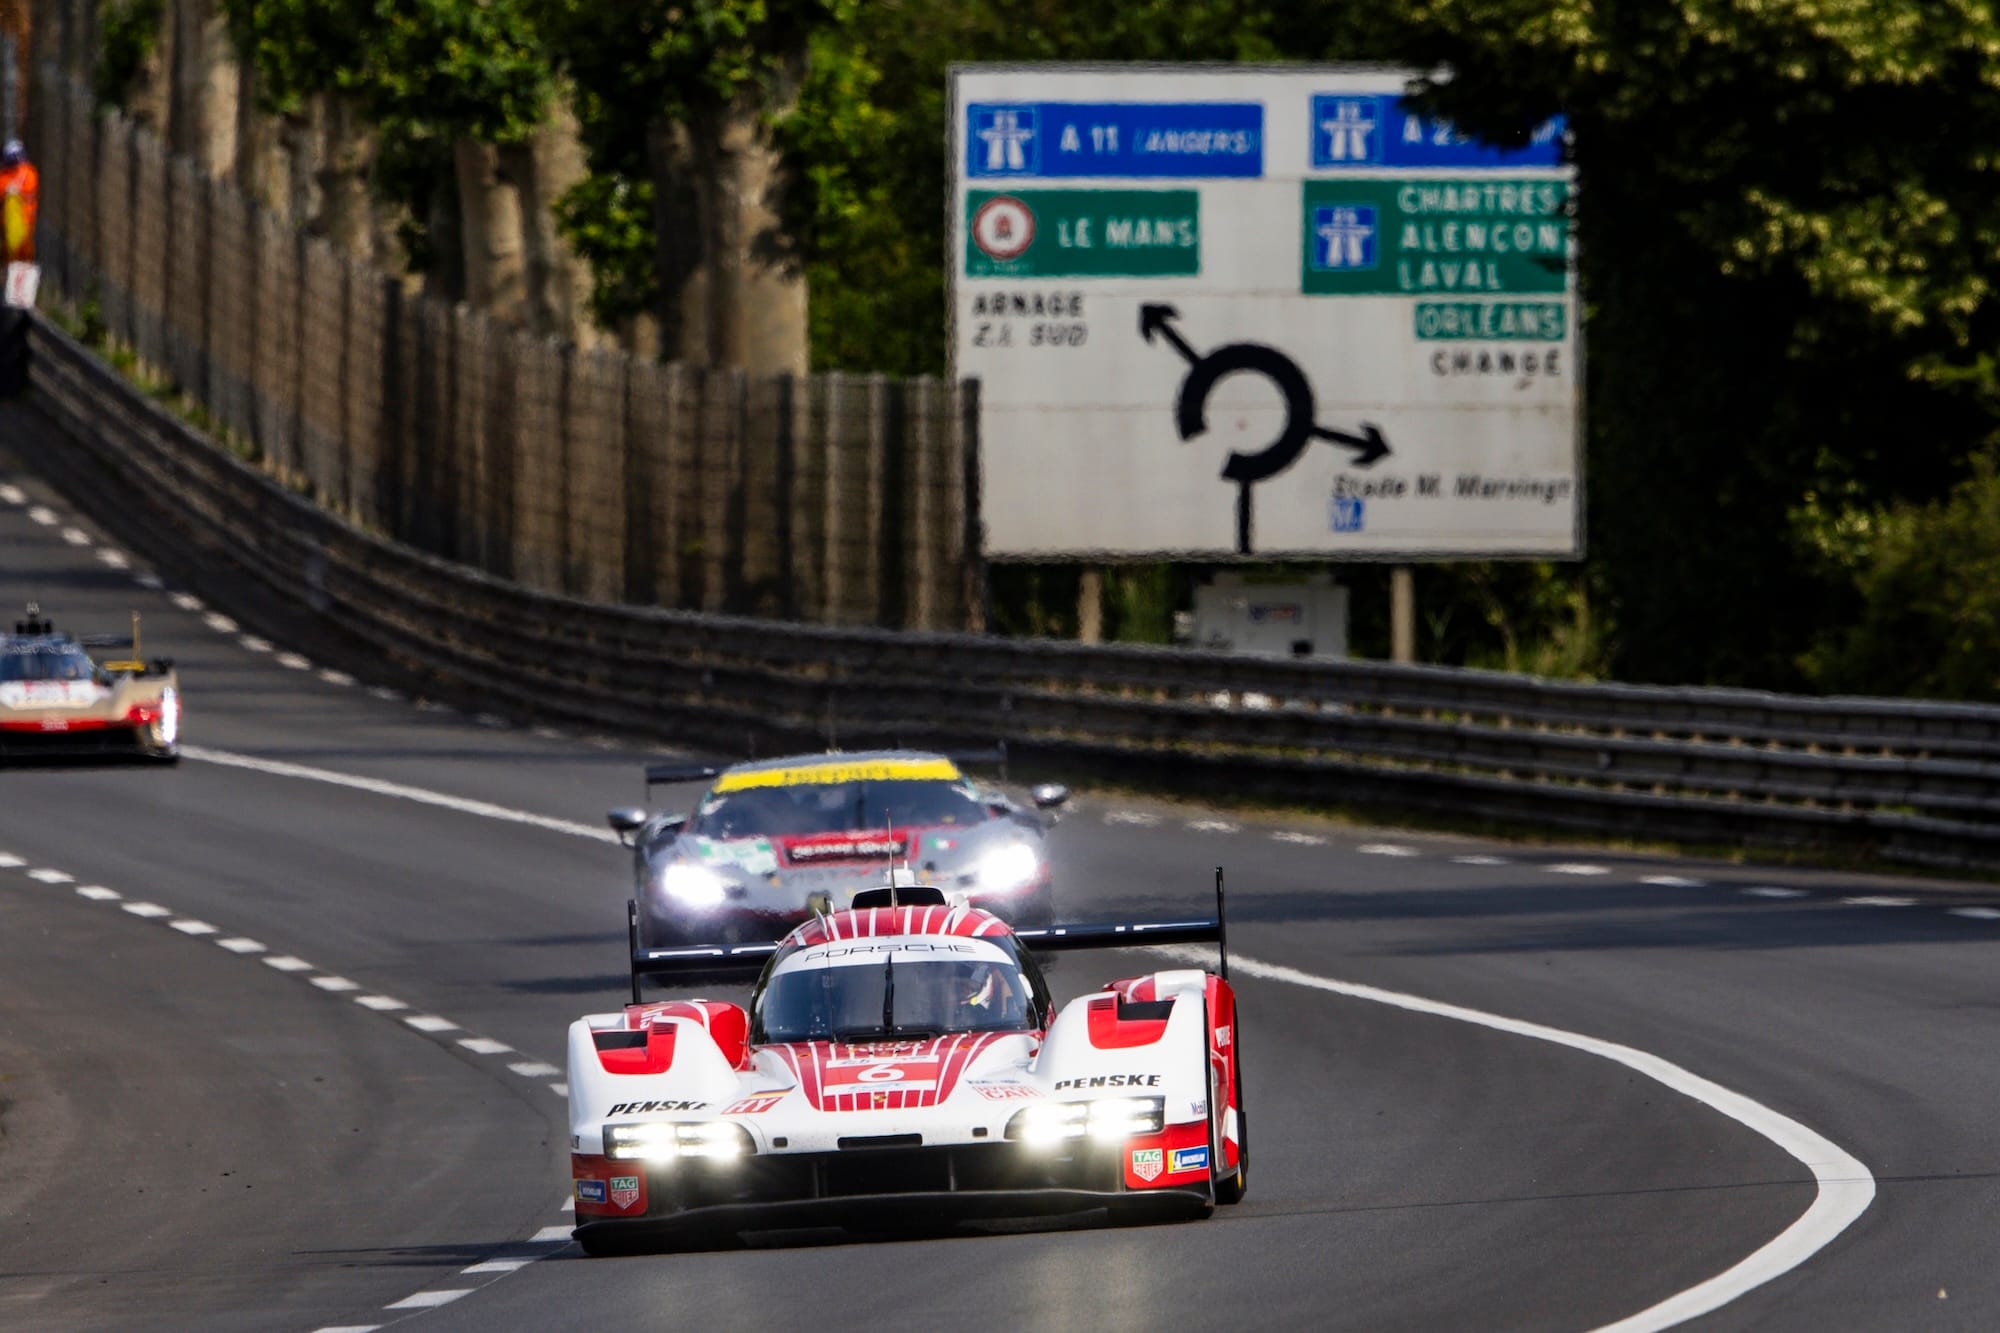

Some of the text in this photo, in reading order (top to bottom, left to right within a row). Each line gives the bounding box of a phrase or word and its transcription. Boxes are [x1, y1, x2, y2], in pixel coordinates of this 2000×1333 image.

[1060, 124, 1081, 152] A
[1089, 125, 1119, 153] 11
[1402, 114, 1421, 143] A
[1399, 184, 1558, 214] CHARTRES
[1057, 216, 1195, 248] LE MANS
[1399, 260, 1502, 290] LAVAL
[971, 291, 1086, 318] ARNAGE
[1029, 321, 1088, 347] SUD
[805, 944, 976, 962] PORSCHE
[857, 1063, 905, 1082] 6
[1055, 1075, 1161, 1090] PENSKE
[606, 1100, 714, 1117] PENSKE
[726, 1097, 780, 1115] HY
[1135, 1151, 1161, 1162] TAG
[612, 1180, 636, 1188] TAG
